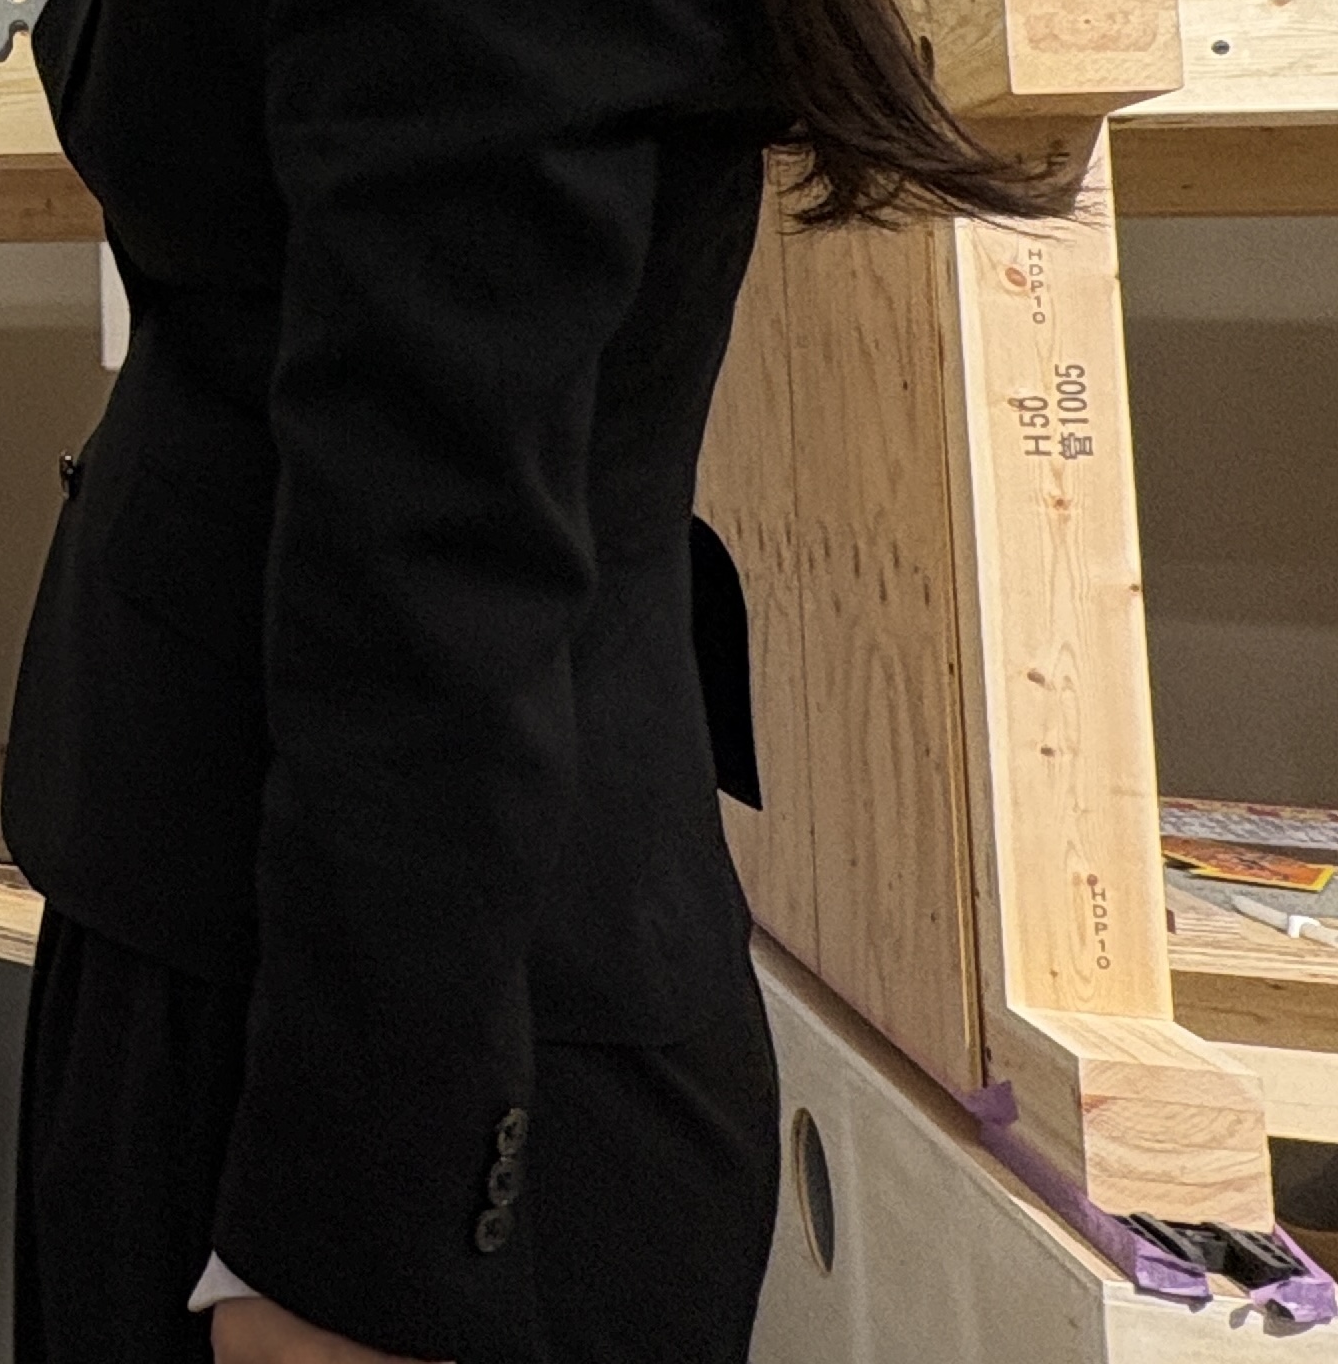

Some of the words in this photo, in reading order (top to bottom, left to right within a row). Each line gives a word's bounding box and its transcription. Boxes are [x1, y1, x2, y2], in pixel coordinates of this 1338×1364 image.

[1028, 247, 1046, 326] HDP10
[1017, 395, 1052, 457] H50
[1054, 363, 1094, 461] 管1005
[1090, 884, 1111, 970] HDP10
